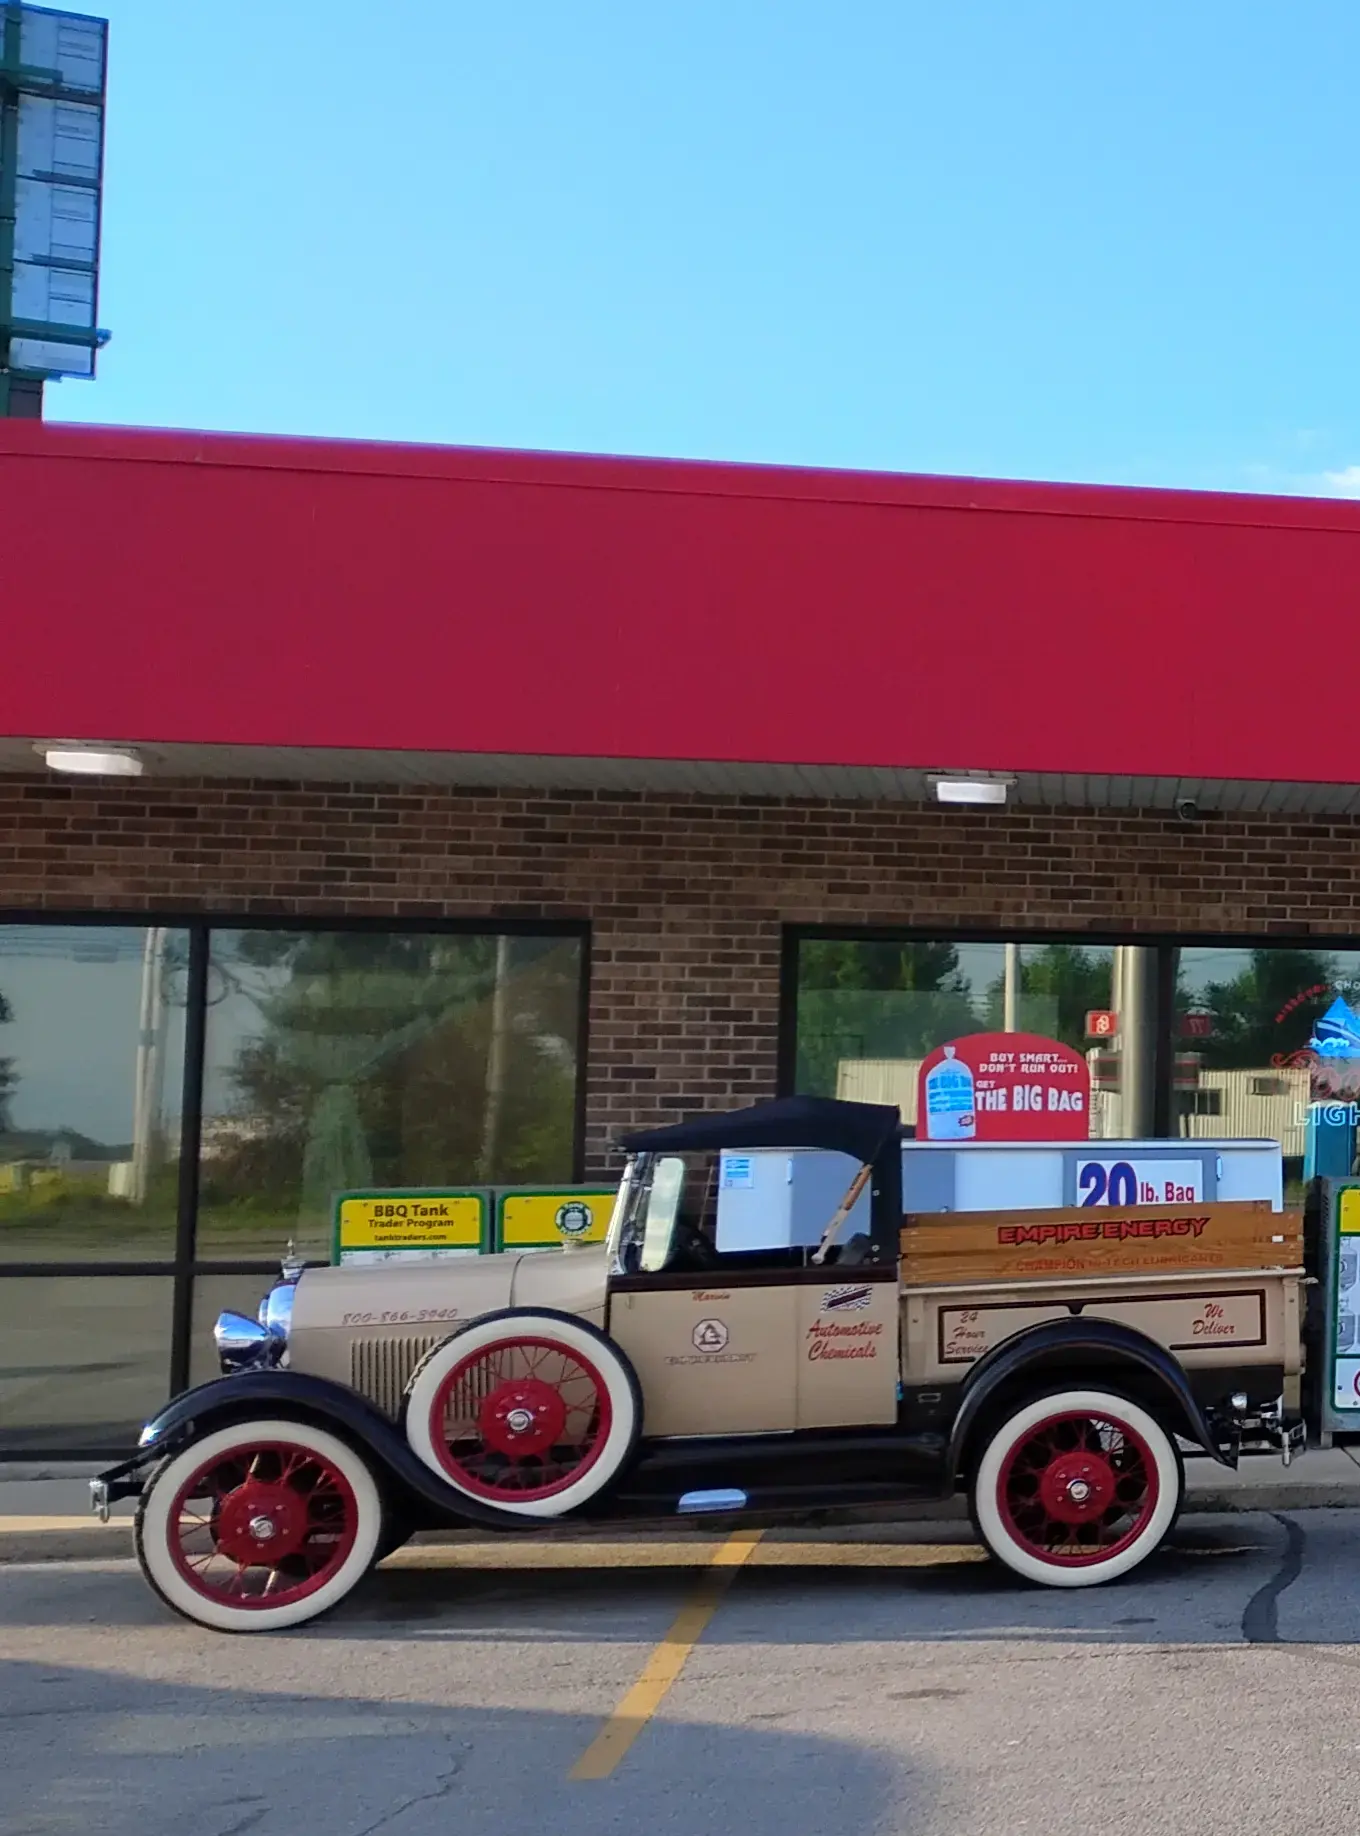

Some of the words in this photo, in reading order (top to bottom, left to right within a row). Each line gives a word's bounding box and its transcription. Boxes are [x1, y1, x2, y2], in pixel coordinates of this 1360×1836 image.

[990, 1053, 1014, 1062] BUY
[979, 1063, 1016, 1073] DON'T
[1020, 1063, 1045, 1073] RUN
[1050, 1063, 1078, 1073] OUT!
[976, 1080, 995, 1088] GET
[975, 1088, 1008, 1111] THE
[1012, 1085, 1042, 1112] BIG
[1047, 1087, 1083, 1112] BAG
[1079, 1162, 1138, 1207] 20
[1140, 1182, 1160, 1202] lb.
[1165, 1182, 1194, 1203] Bag
[374, 1204, 408, 1217] BBQ
[413, 1204, 449, 1216] Tank
[368, 1218, 403, 1228] Trader
[406, 1218, 454, 1229] Program
[998, 1222, 1100, 1246] EMPIRE
[1101, 1217, 1211, 1241] ENERGY
[1204, 1303, 1224, 1318] We
[806, 1319, 884, 1340] Automotive
[953, 1326, 986, 1339] Hour
[1192, 1319, 1236, 1335] Deliver
[808, 1342, 877, 1361] Chemicals
